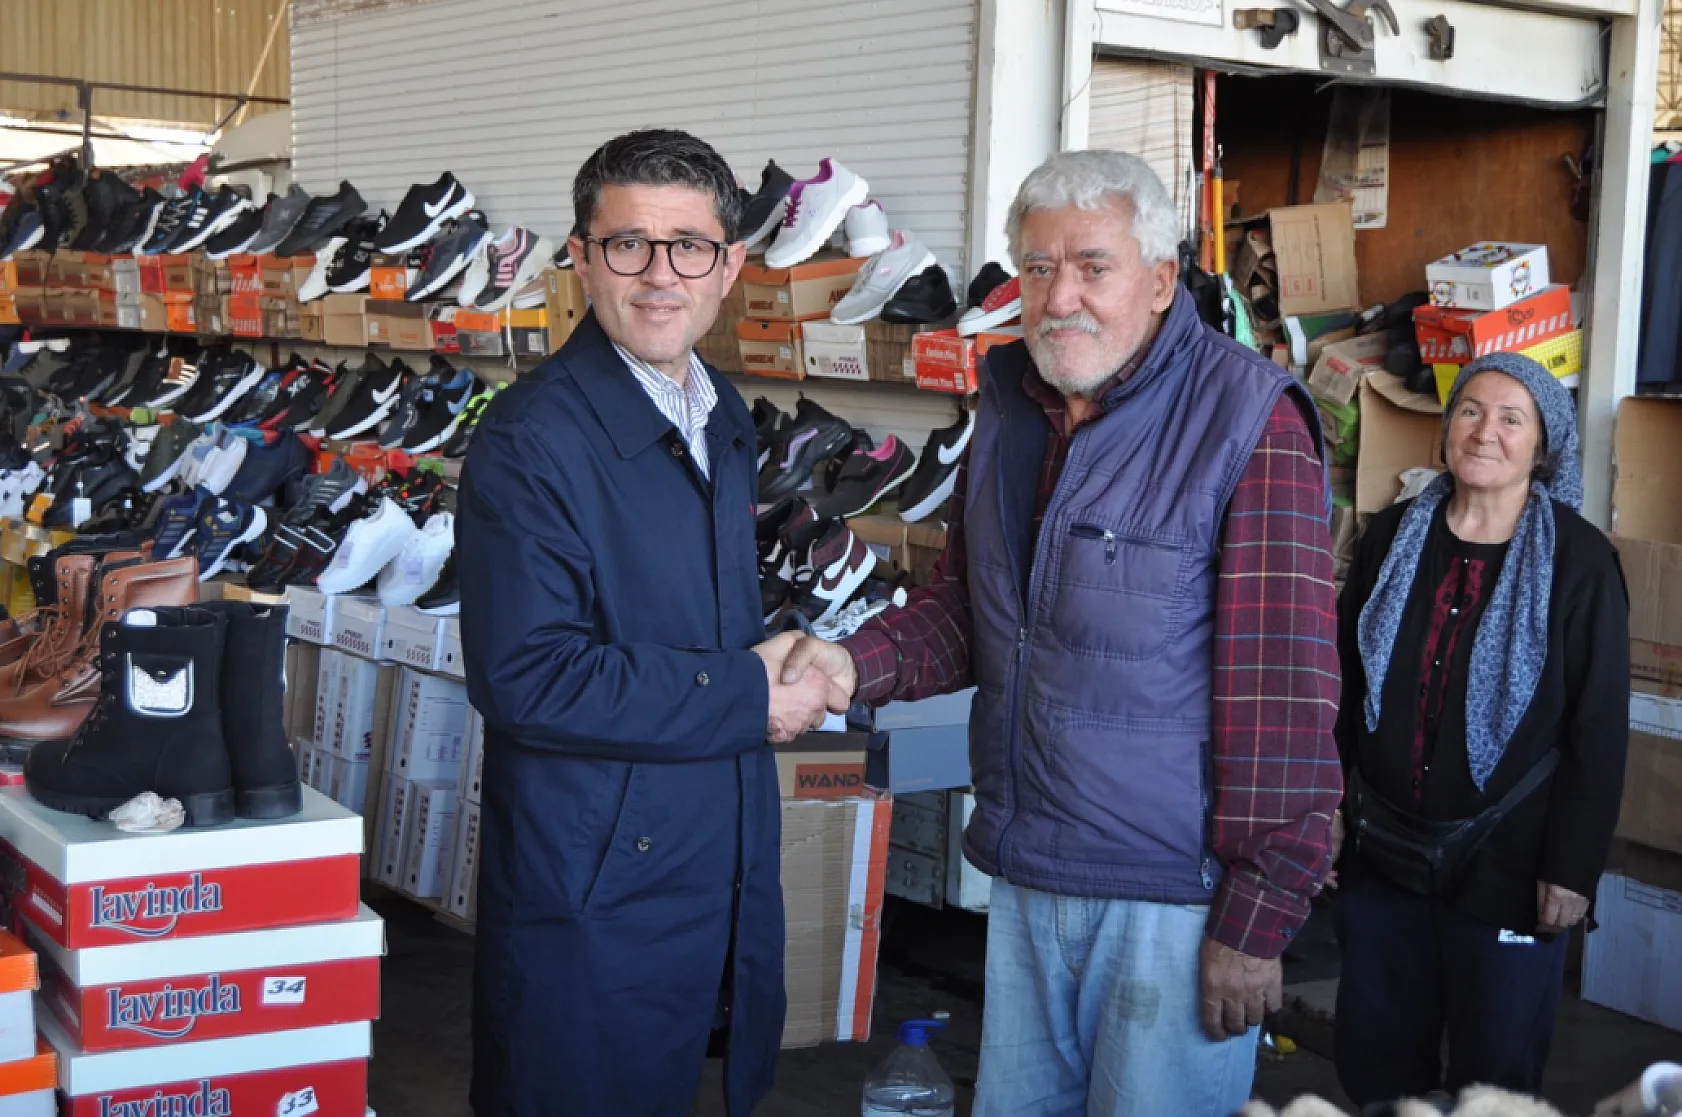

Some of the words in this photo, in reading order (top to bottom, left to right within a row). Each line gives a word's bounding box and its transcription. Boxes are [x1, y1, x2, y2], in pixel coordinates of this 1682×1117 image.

[798, 772, 861, 788] WAND
[89, 872, 223, 936] Lavinda
[106, 973, 242, 1038] Lavinda
[267, 979, 306, 995] 34
